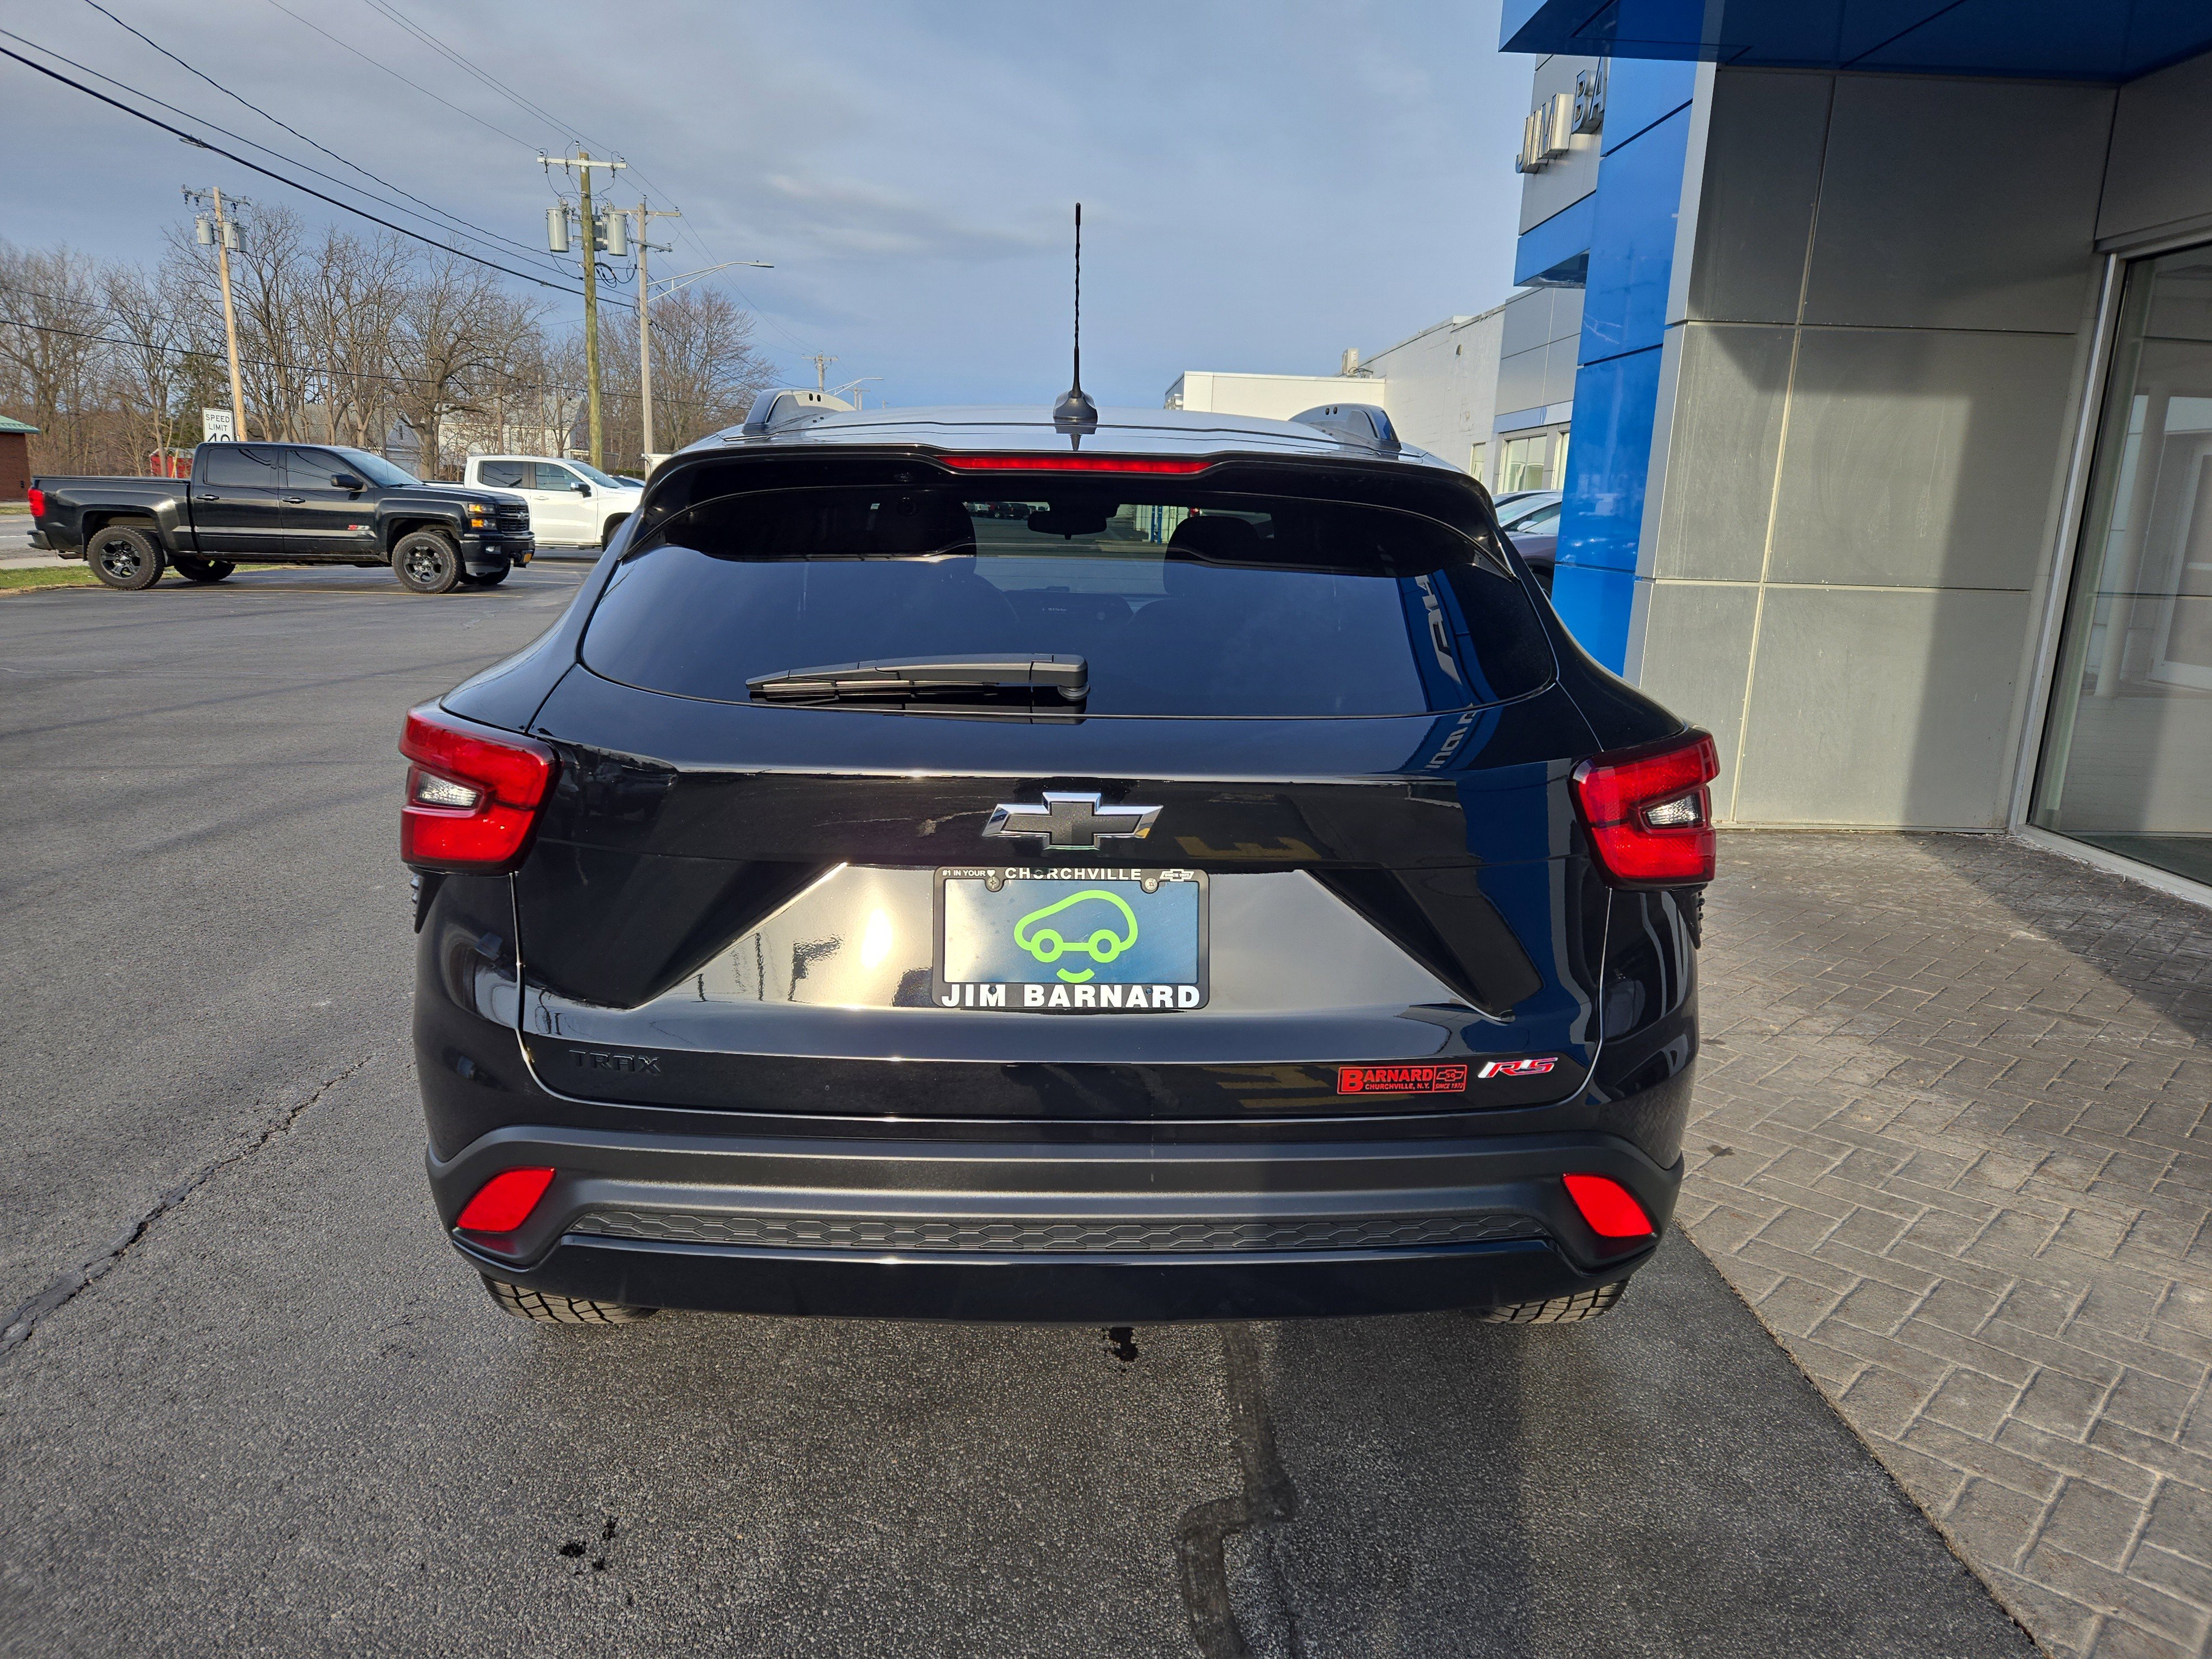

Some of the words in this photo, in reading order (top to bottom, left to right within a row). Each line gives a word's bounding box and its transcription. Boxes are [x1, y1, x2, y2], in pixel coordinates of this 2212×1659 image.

[206, 414, 230, 423] SPEED
[209, 423, 228, 432] LIMIT
[942, 984, 1006, 1007] JIM
[1024, 984, 1200, 1008] BARNARD
[569, 1049, 661, 1074] TRAX
[1477, 1057, 1558, 1078] RS
[1341, 1069, 1433, 1091] BARNARD
